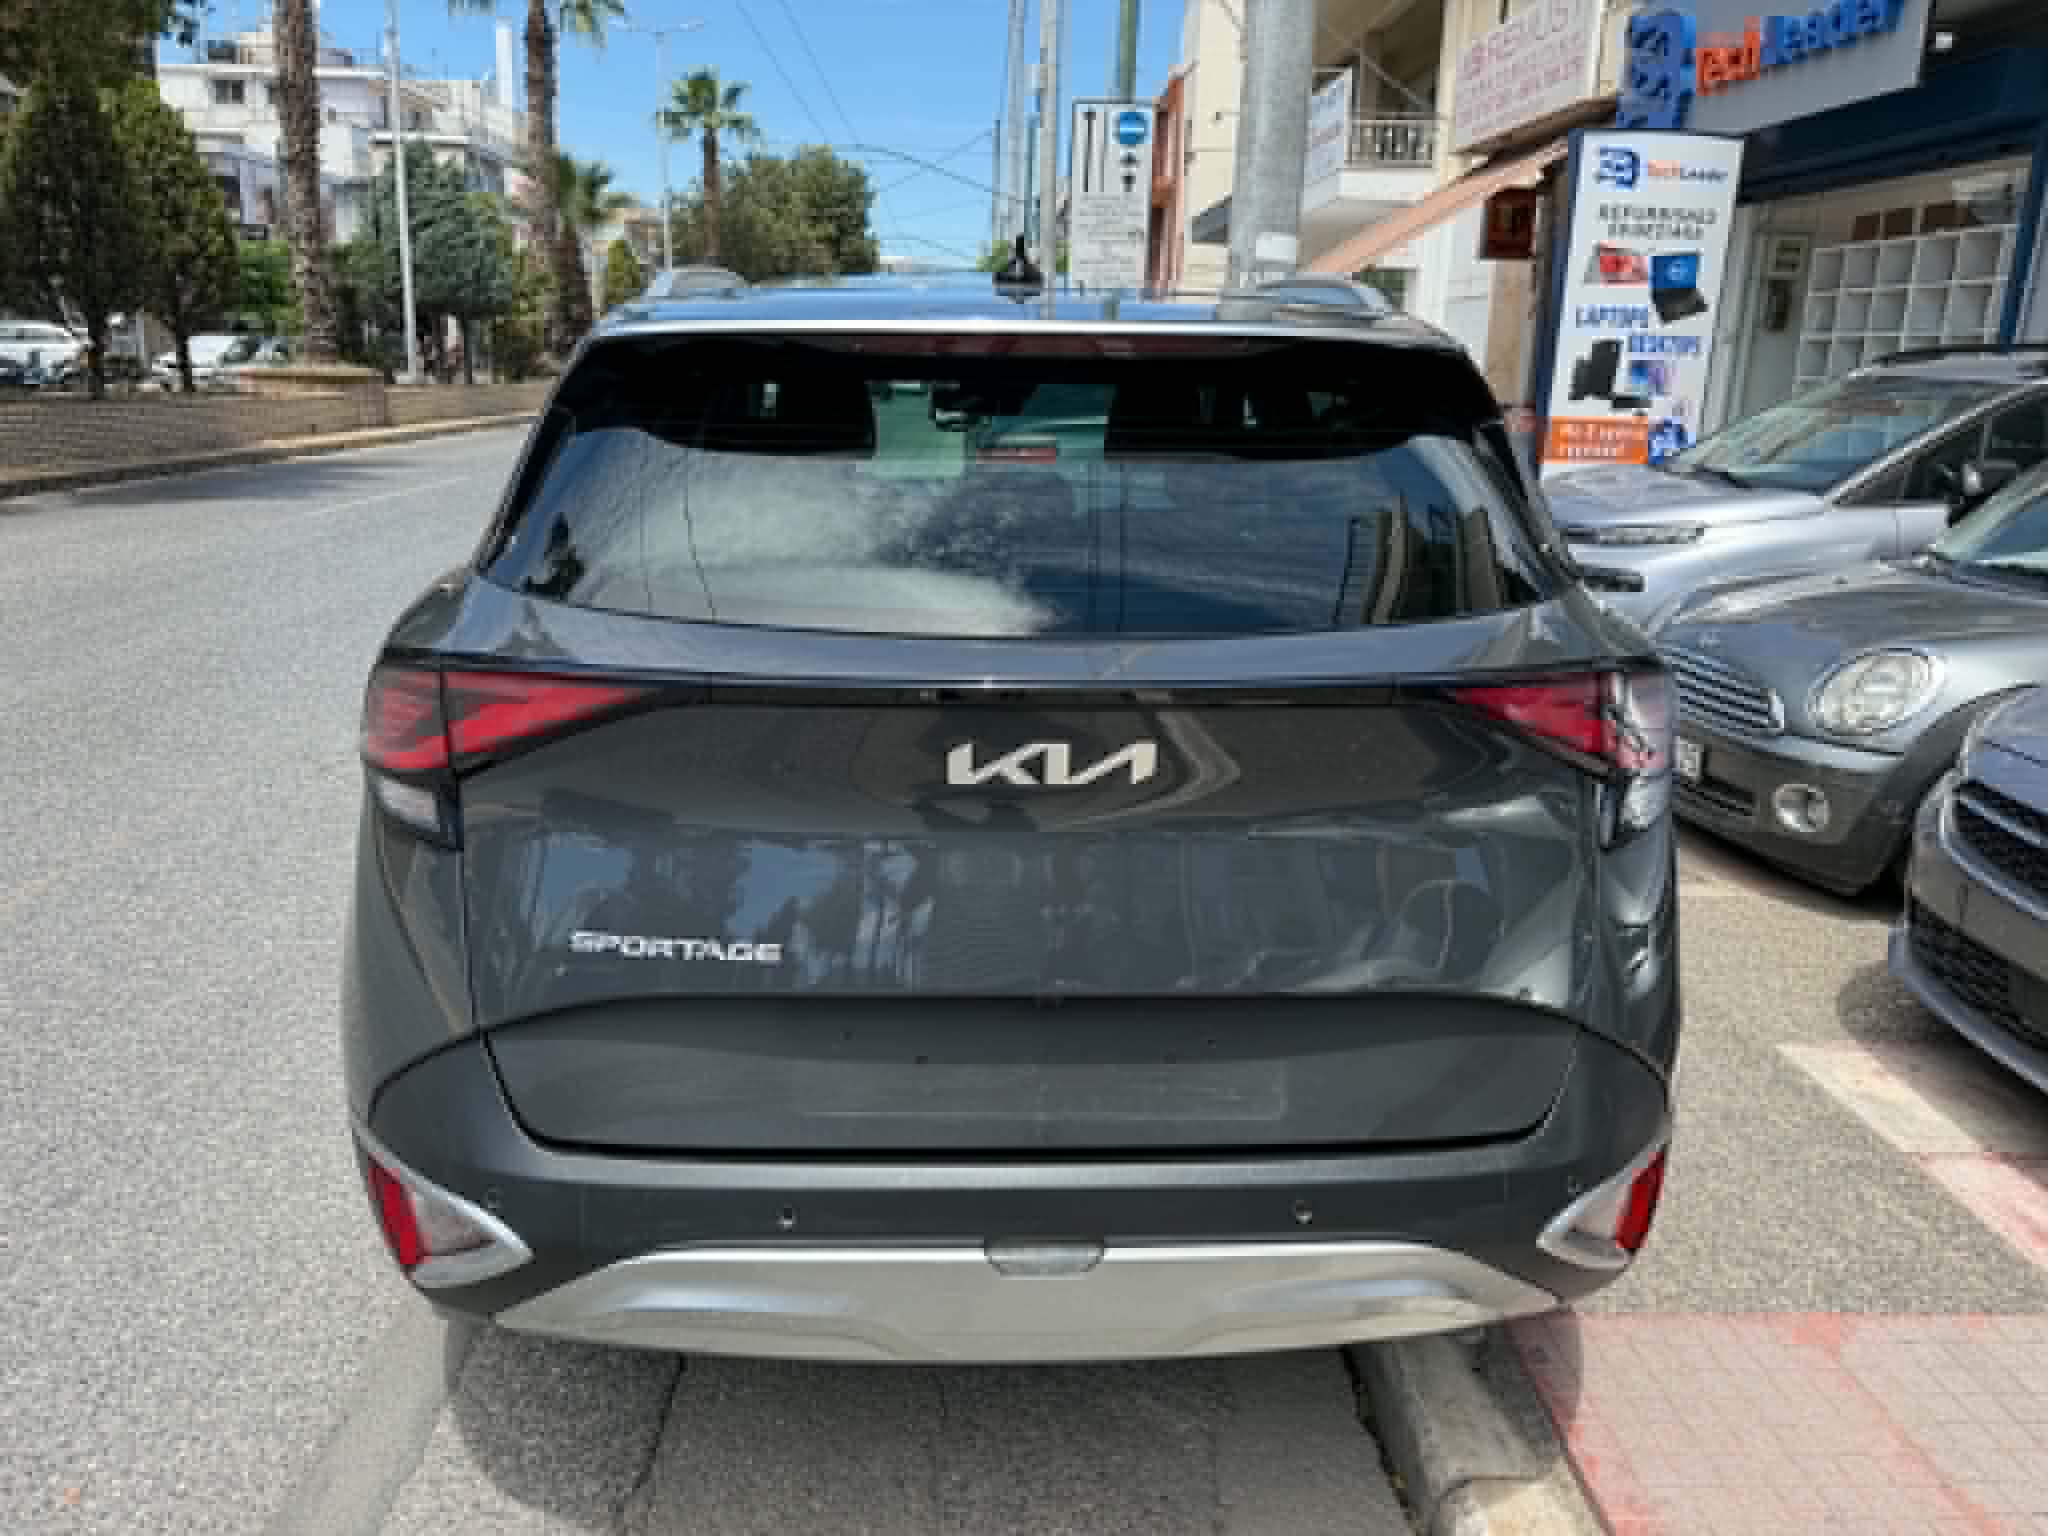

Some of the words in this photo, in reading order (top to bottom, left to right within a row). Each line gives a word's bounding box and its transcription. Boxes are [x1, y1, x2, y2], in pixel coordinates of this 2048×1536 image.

[1575, 305, 1650, 329] LAPTOPS
[946, 743, 1158, 785] KIA
[570, 930, 784, 964] SPORTAGE
